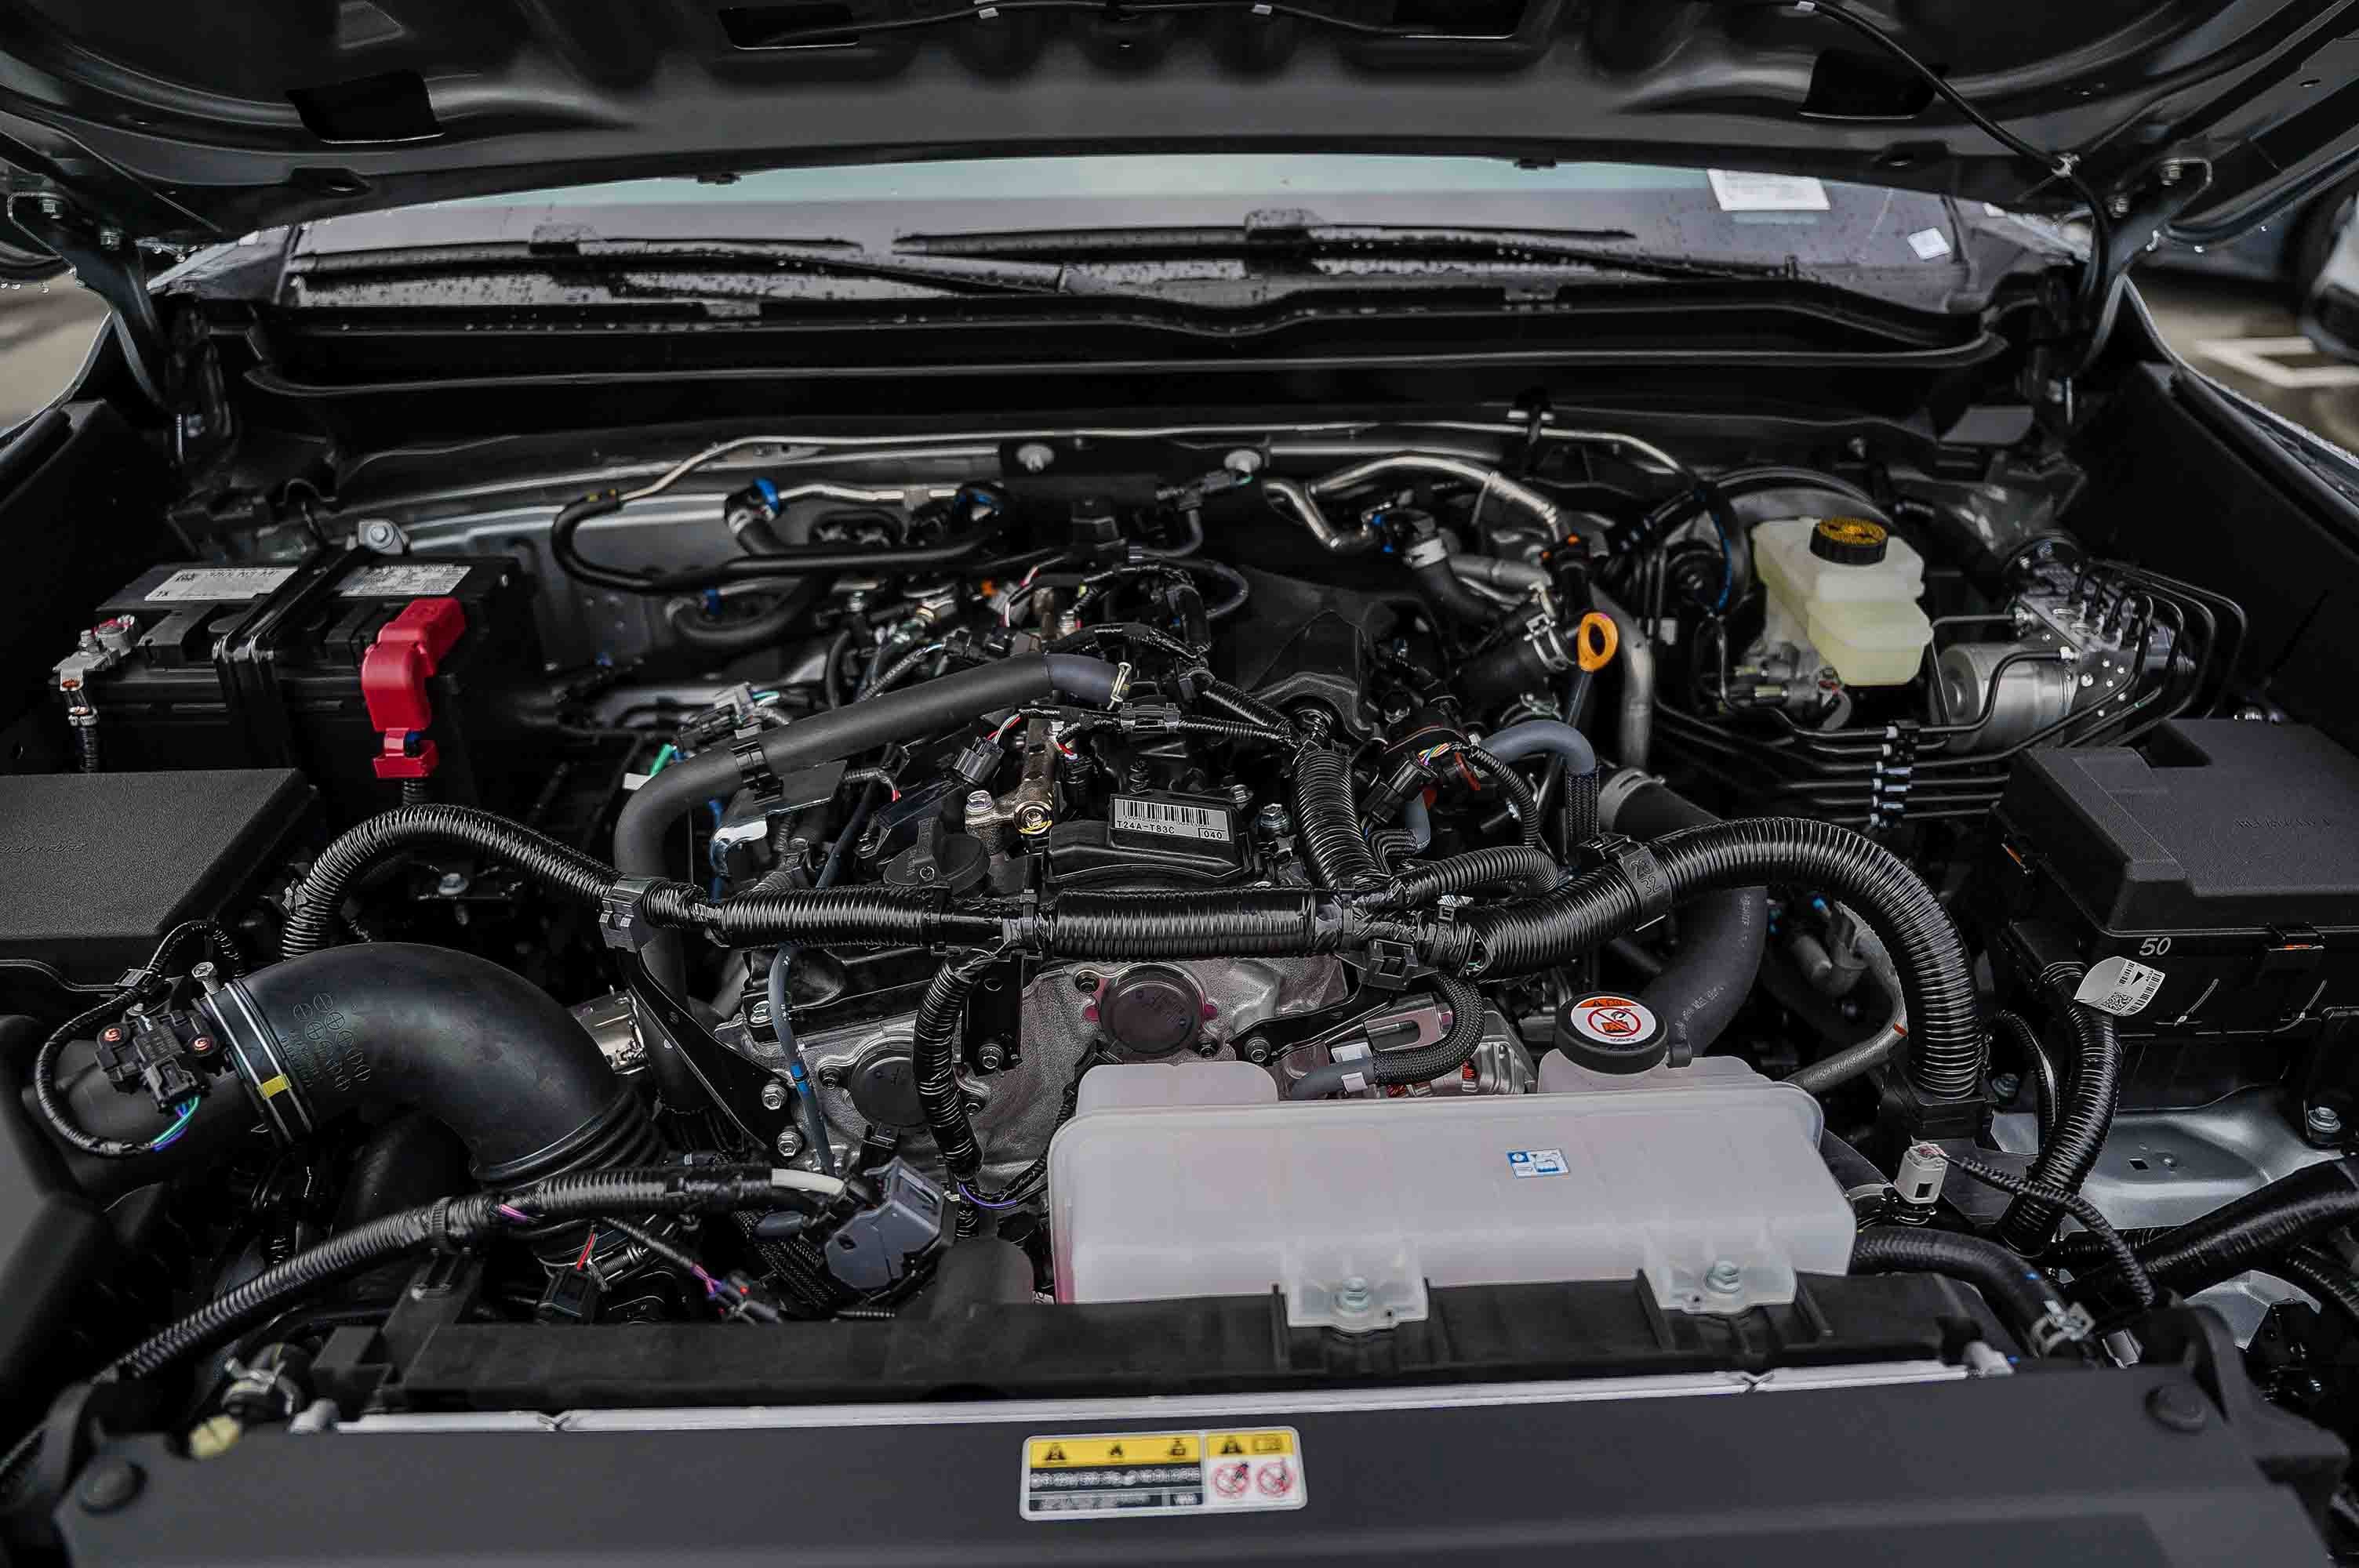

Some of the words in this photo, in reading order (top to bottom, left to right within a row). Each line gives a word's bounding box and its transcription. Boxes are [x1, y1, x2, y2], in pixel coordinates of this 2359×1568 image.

[1117, 821, 1175, 833] T24A-T83C
[1203, 830, 1223, 839] 040
[2139, 937, 2172, 956] 50
